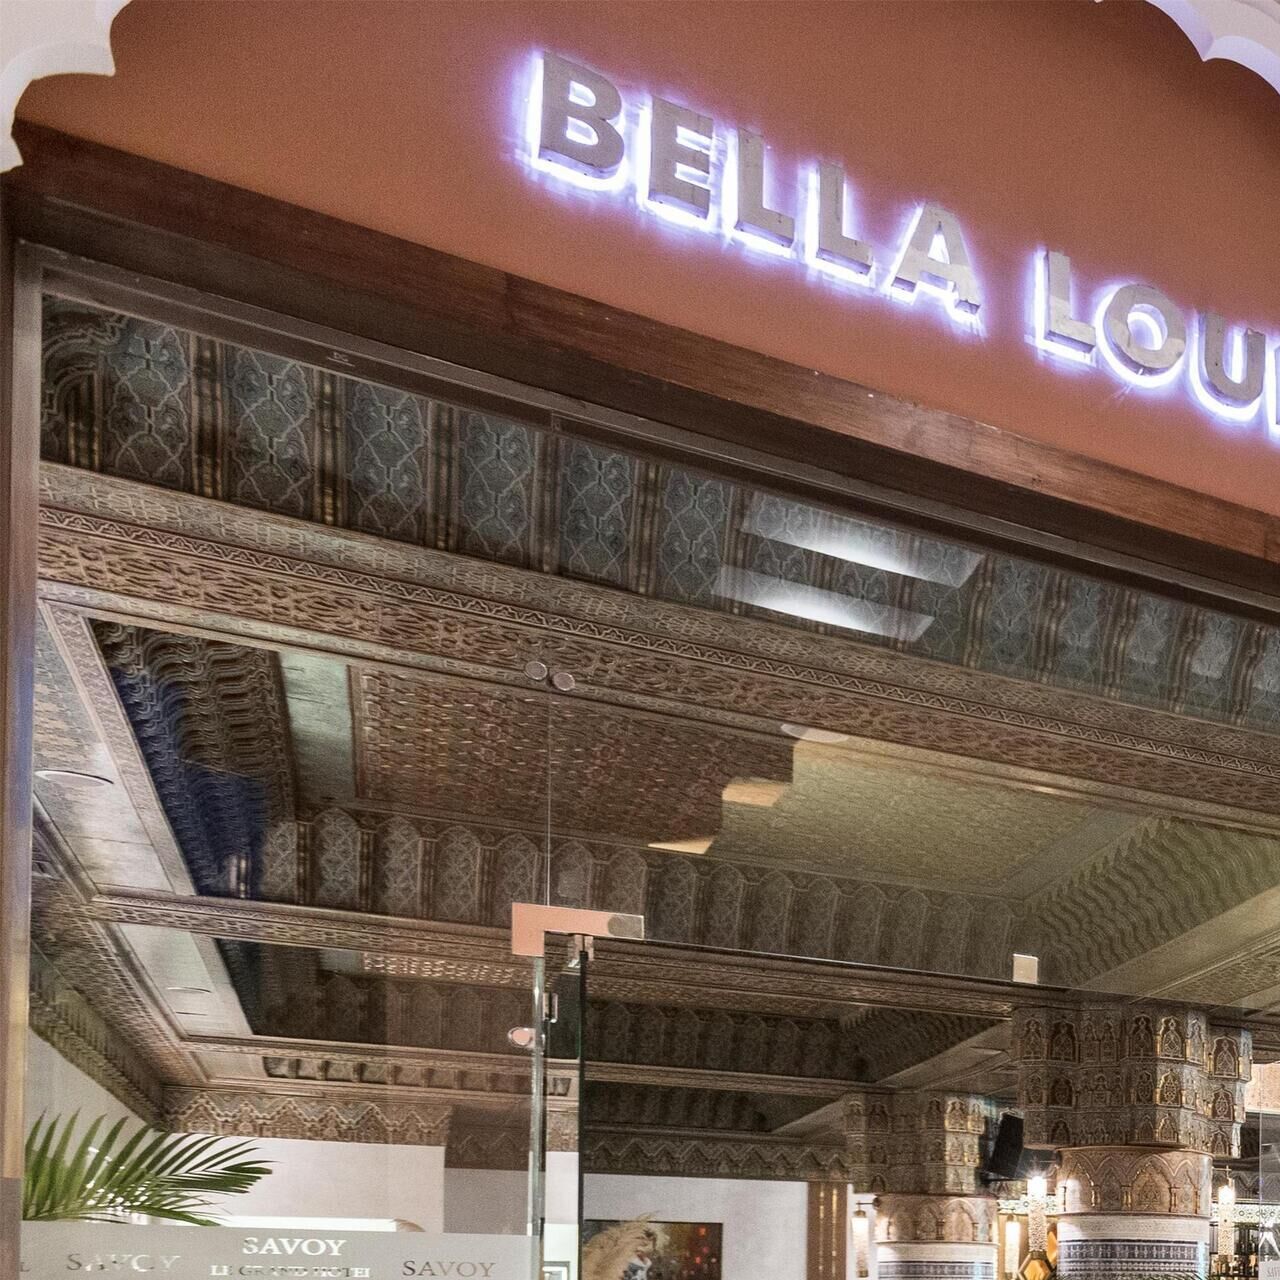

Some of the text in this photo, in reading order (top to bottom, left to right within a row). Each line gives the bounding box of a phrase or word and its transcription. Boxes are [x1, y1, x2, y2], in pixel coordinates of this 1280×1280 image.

[536, 48, 984, 320] BELLA
[242, 1236, 347, 1256] SAVOY
[209, 1264, 233, 1277] LE
[402, 1260, 497, 1278] SAVOY
